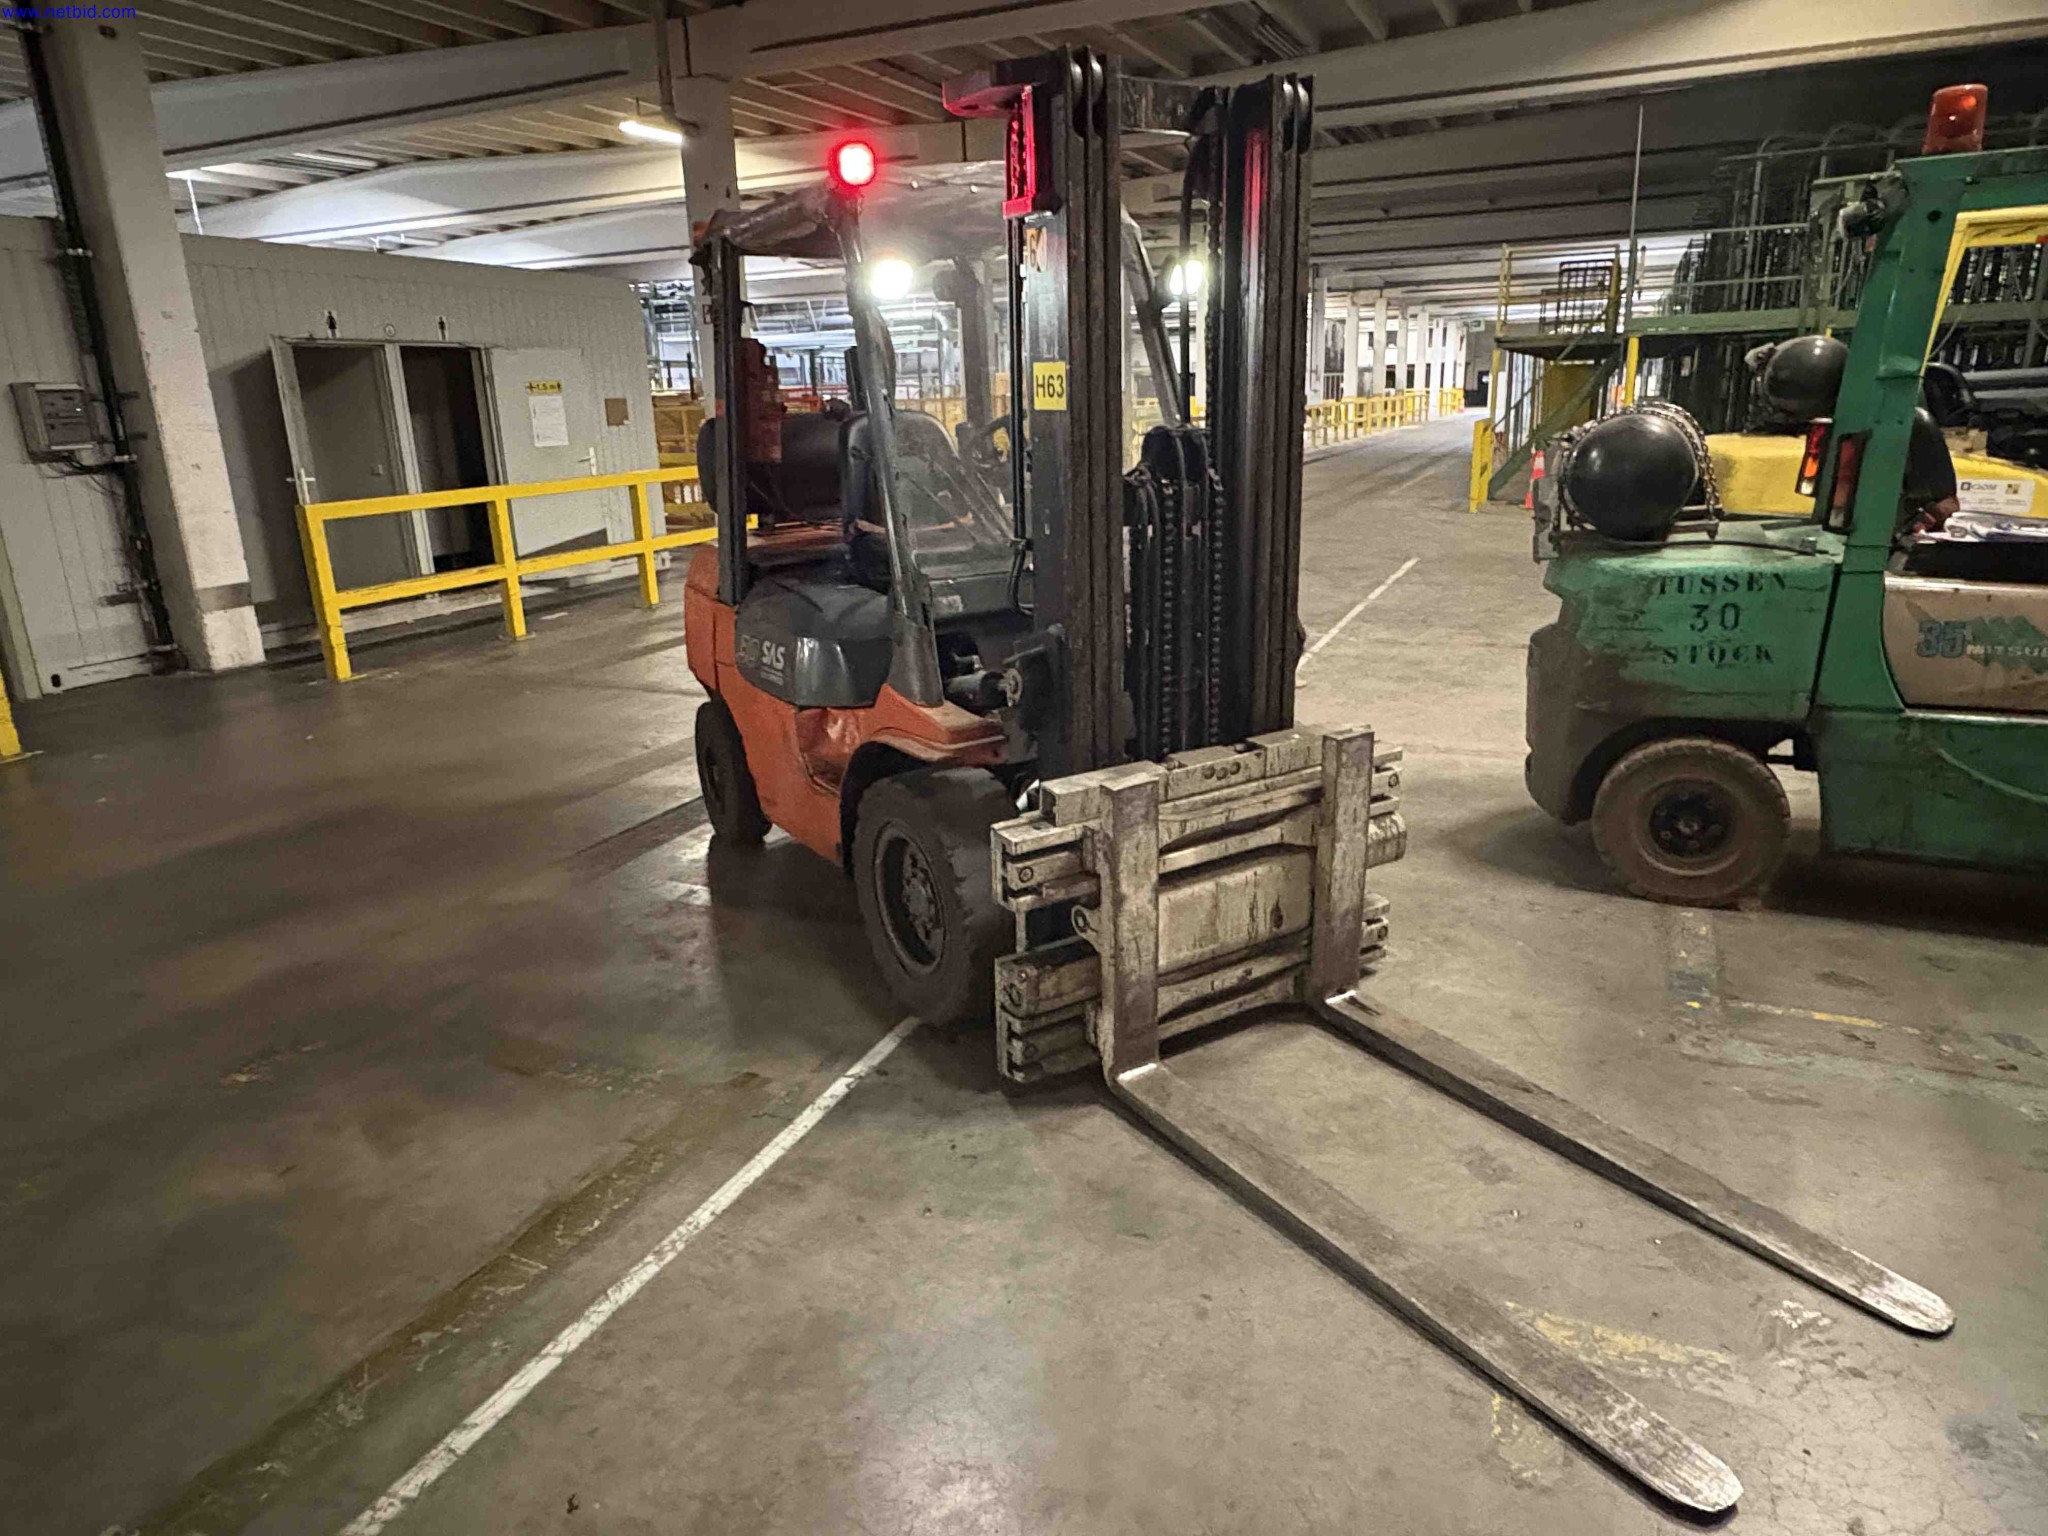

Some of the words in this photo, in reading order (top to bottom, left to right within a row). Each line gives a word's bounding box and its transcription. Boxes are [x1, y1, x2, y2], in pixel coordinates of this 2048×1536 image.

[1036, 374, 1064, 398] H63
[1656, 571, 1786, 596] TUSSEN
[1689, 602, 1741, 632] 30
[761, 640, 786, 671] SAS
